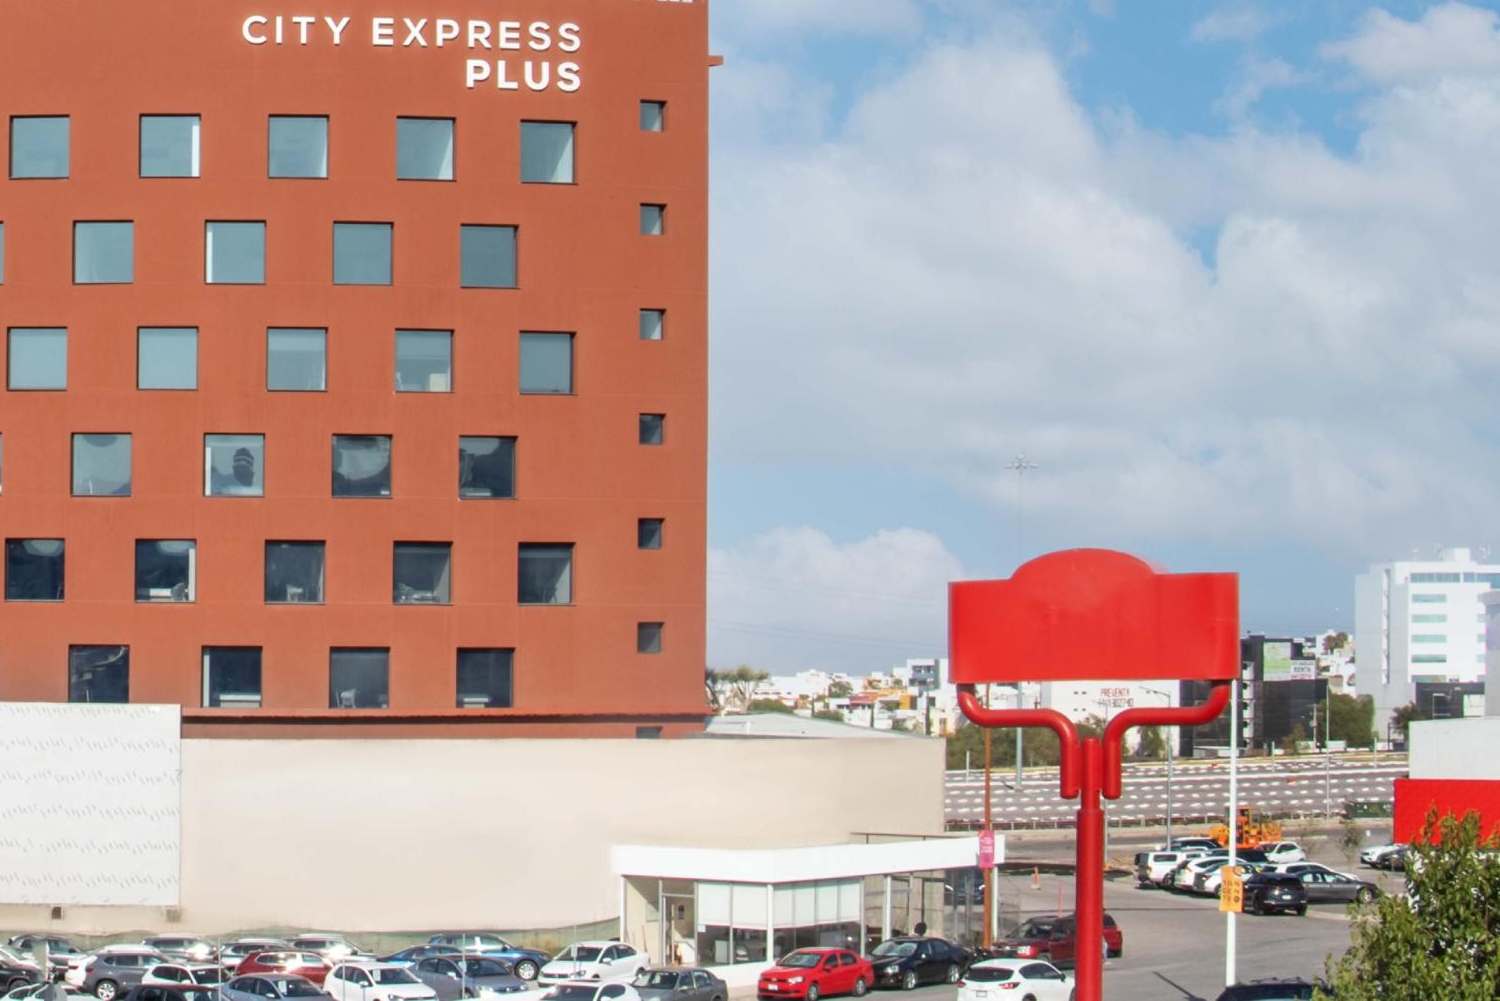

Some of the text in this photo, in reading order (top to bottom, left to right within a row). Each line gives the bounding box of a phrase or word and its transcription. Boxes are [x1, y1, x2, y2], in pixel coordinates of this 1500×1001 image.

[242, 15, 582, 53] CITY EXPRESS
[465, 59, 582, 92] PLUS
